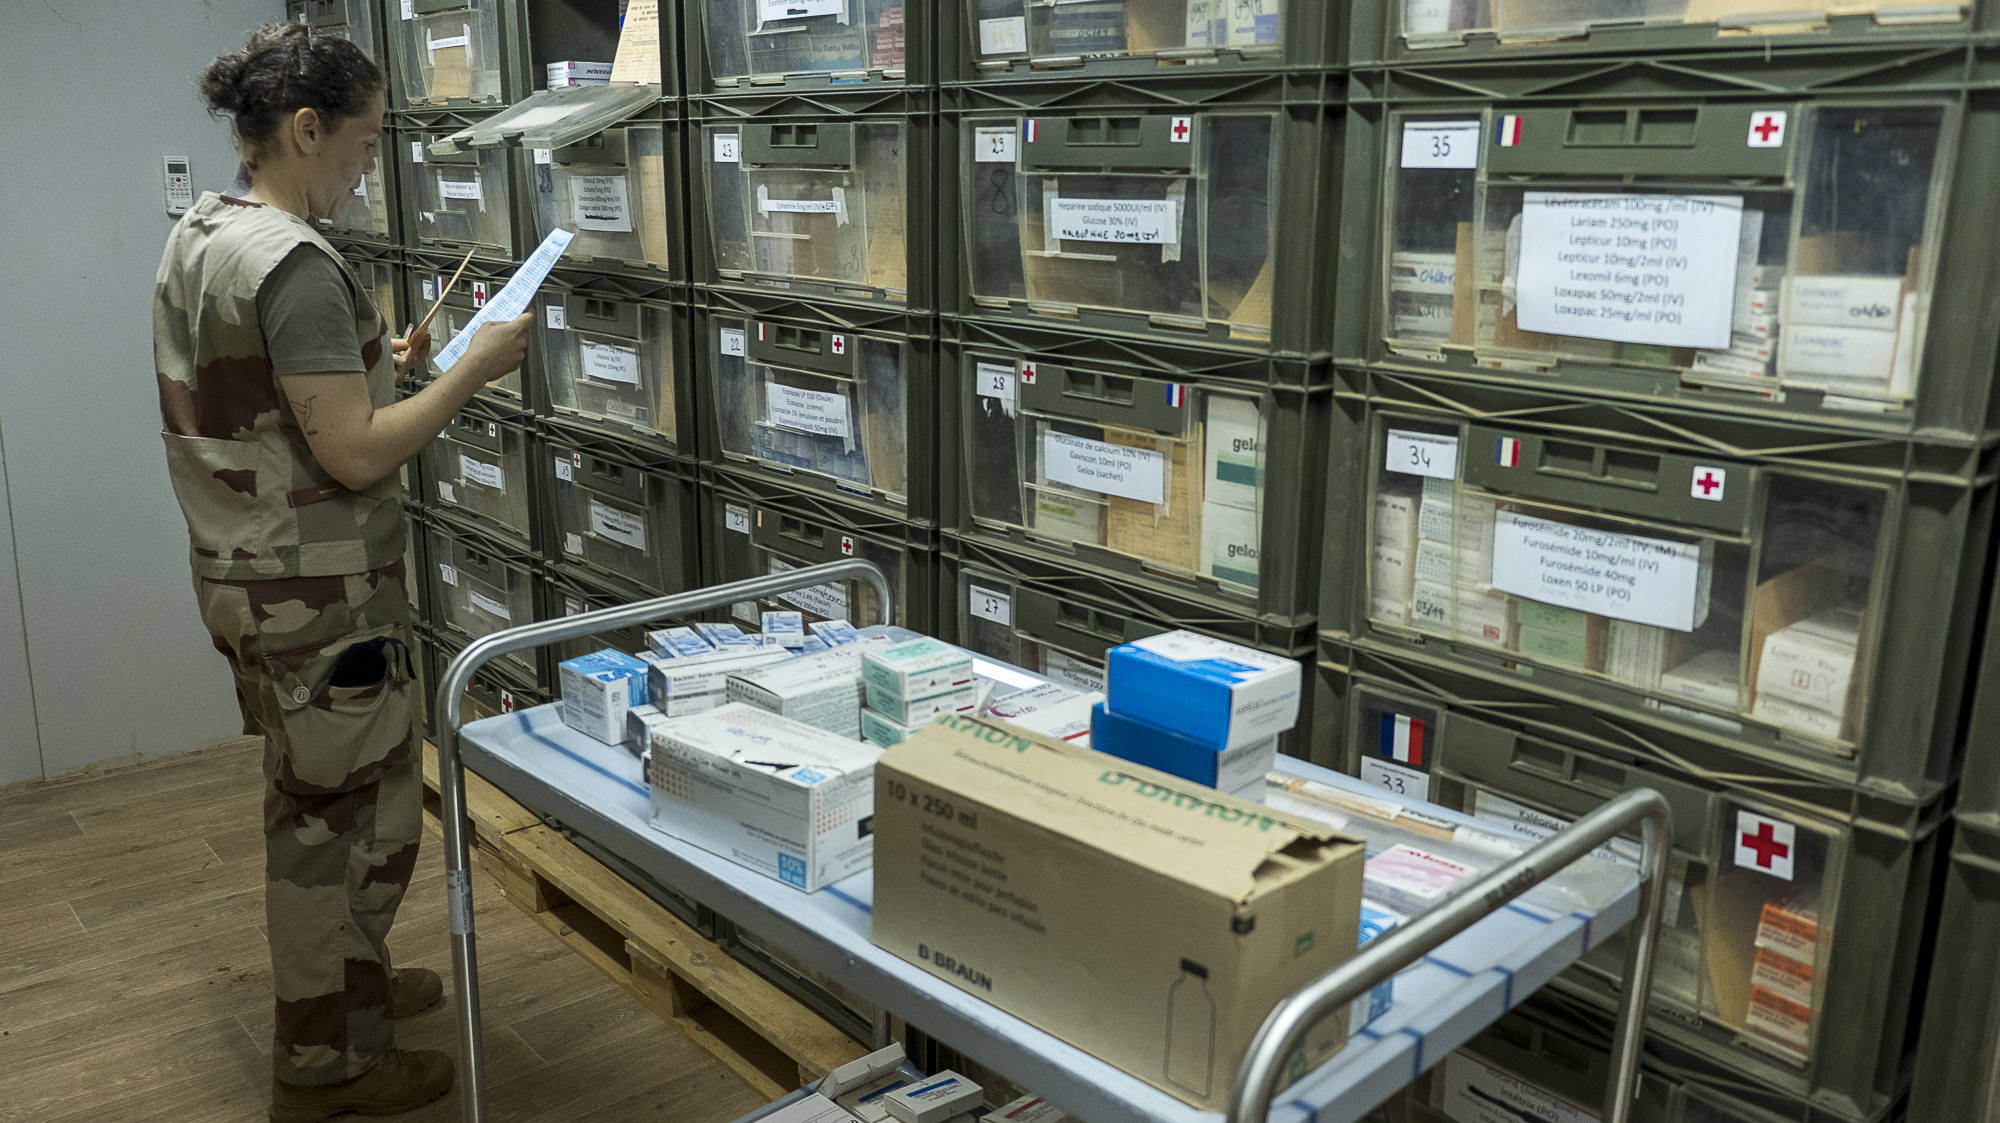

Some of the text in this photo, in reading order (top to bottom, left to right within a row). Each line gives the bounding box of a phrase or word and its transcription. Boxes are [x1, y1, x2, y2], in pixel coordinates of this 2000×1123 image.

[1431, 135, 1451, 157] 35
[1082, 216, 1107, 225] Glucose
[1570, 216, 1679, 232] Lariam 250mg (PO)
[1569, 233, 1678, 251] Lepticur 10mg (PO)
[1558, 250, 1688, 271] Lepticur 10mg/2ml (IV)
[1570, 270, 1669, 288] Lexomil 6mg (PO)
[1554, 286, 1685, 307] Loxapac 50mg/2ml (IV)
[1554, 303, 1682, 325] Loxapac 25mg/ml (PO)
[730, 338, 741, 351] 22
[993, 377, 1005, 390] 28
[1409, 445, 1431, 468] 34
[1513, 516, 1570, 539] Furosémide
[1572, 529, 1630, 549] 20mg/2ml
[1523, 535, 1660, 574] Furosémide 10mg/ml (IV)
[1540, 556, 1636, 586] Furosémide 40mg
[1541, 572, 1631, 601] Loxen 50 LP (PO)
[985, 599, 999, 614] 27
[1381, 774, 1405, 794] 33
[887, 780, 978, 831] 10 x 250 ml
[917, 943, 993, 993] B BRAUN
